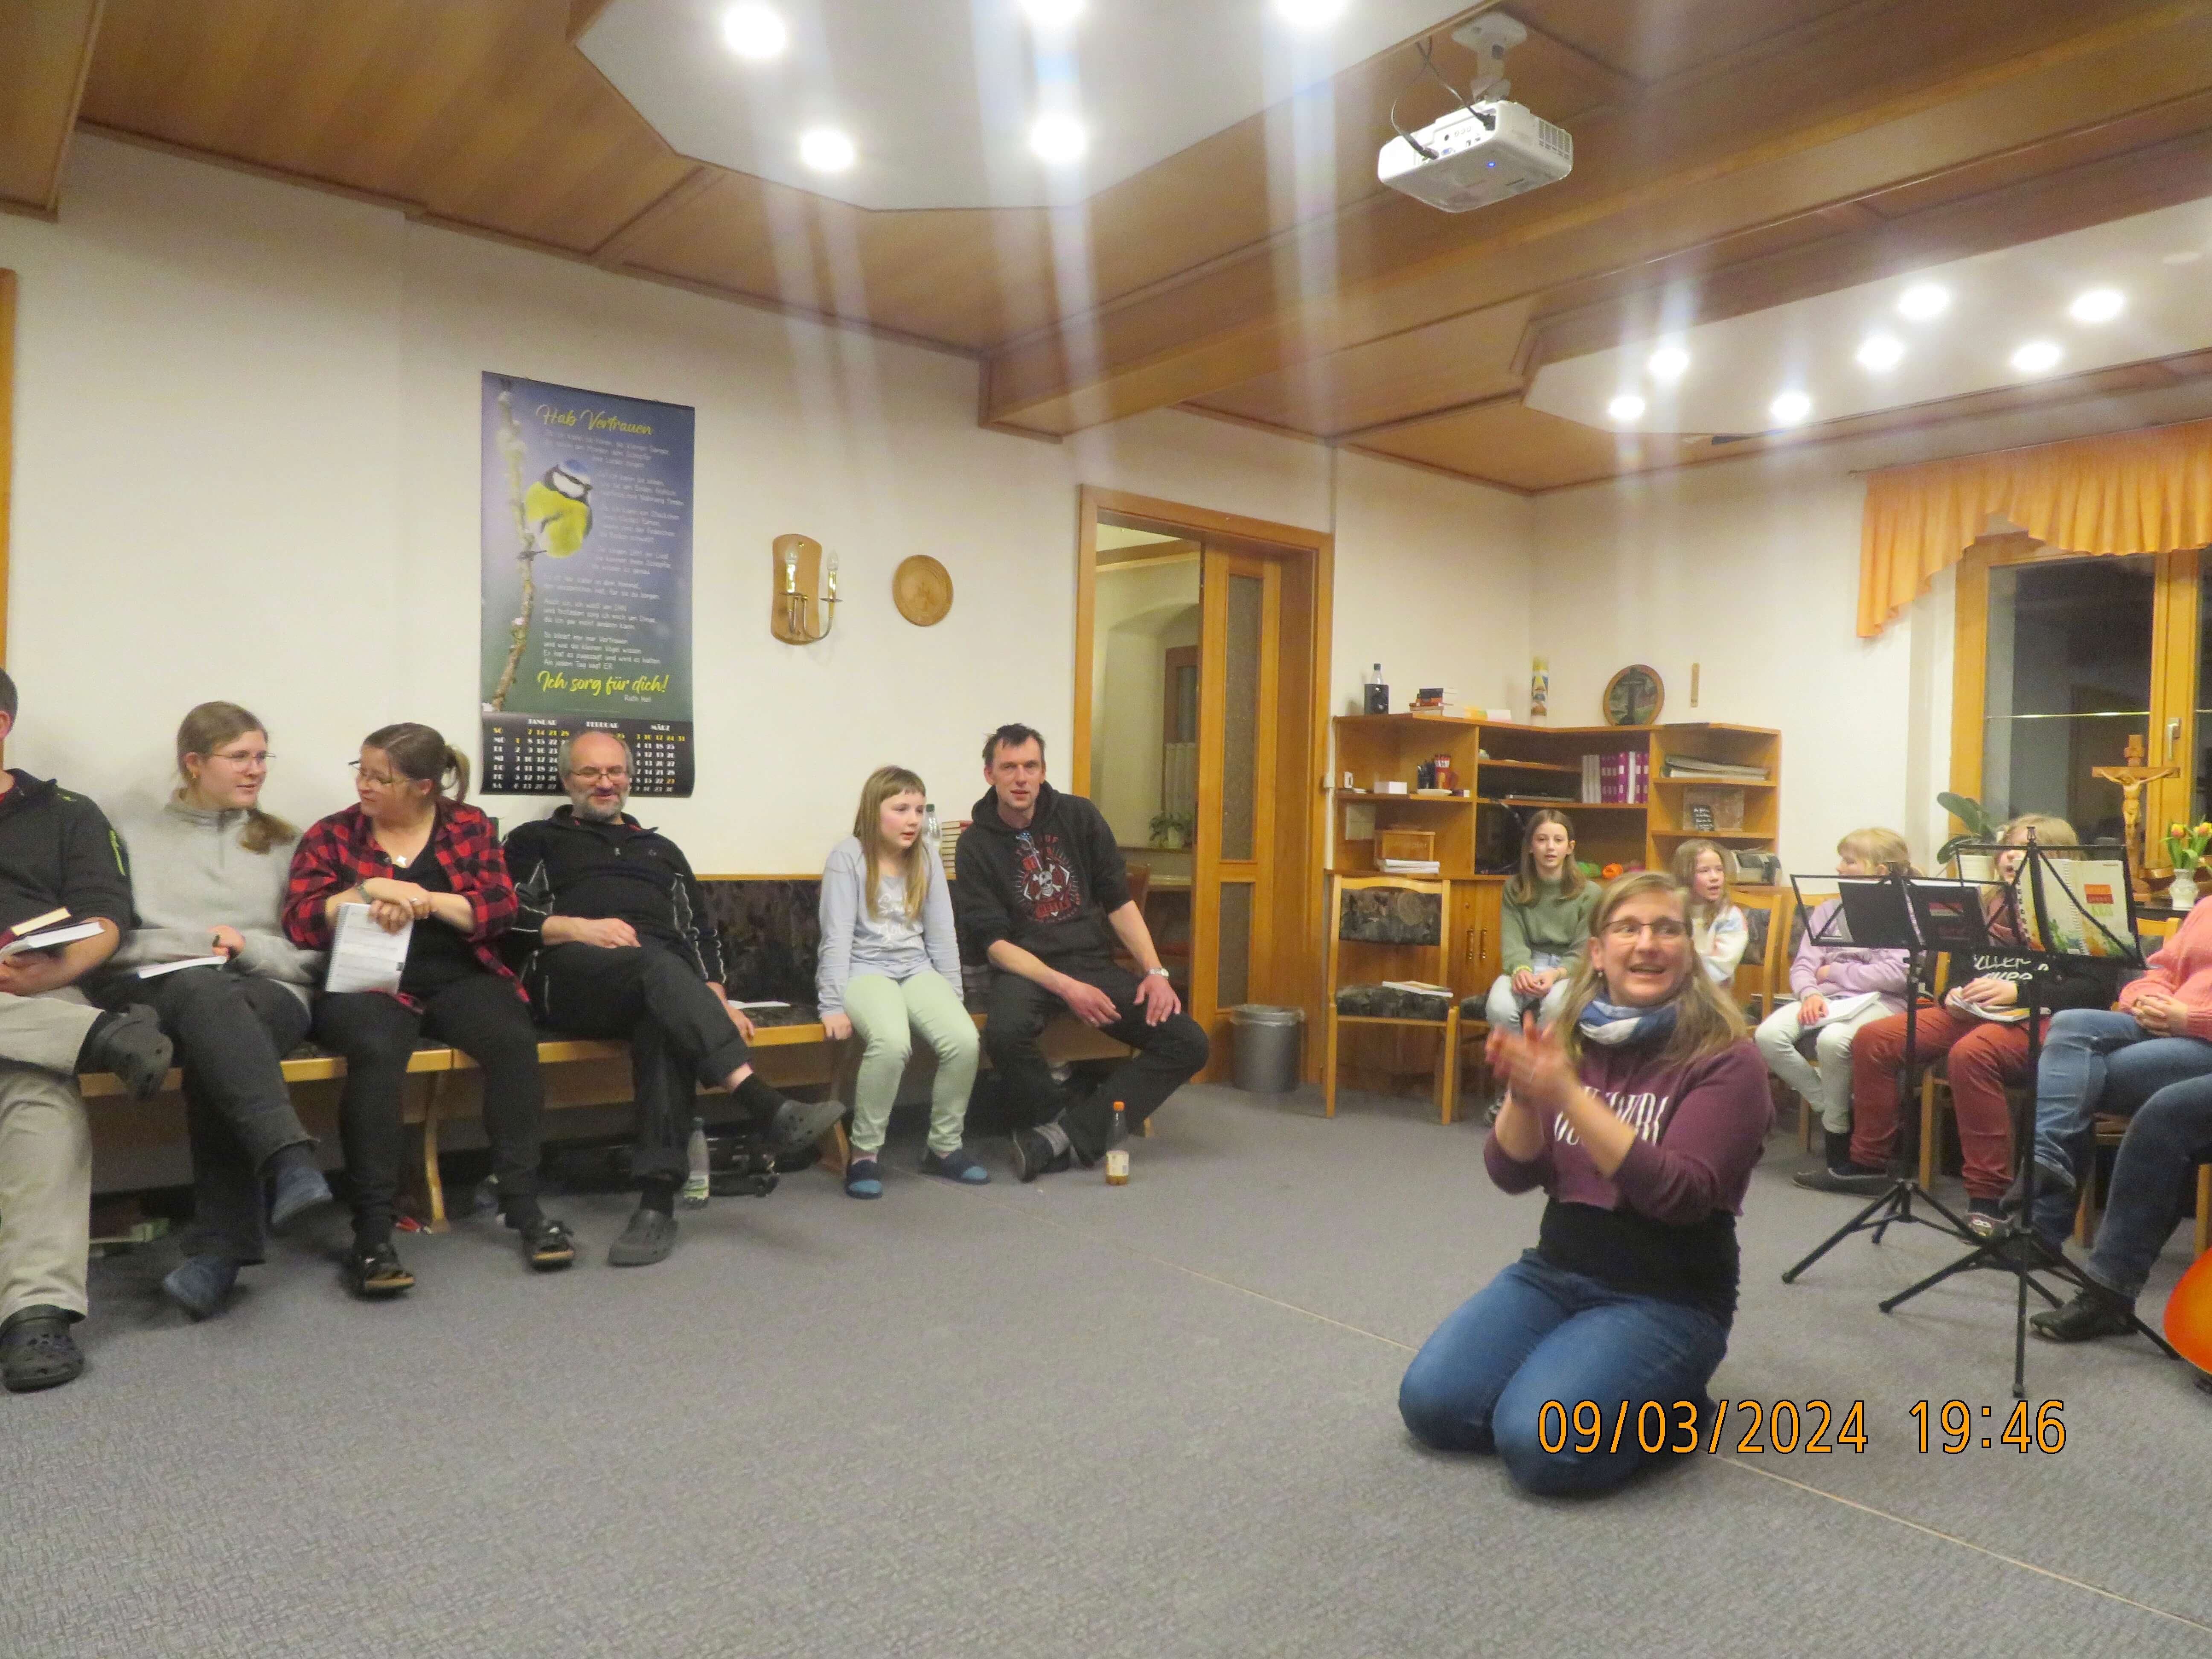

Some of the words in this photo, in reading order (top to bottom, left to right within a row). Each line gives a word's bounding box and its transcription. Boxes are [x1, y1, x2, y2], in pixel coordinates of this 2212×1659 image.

[536, 404, 577, 426] Hab
[580, 409, 653, 435] Vertrauen
[537, 670, 567, 693] Ich
[570, 678, 601, 696] sorg
[606, 676, 629, 696] für
[631, 674, 669, 694] dich!
[586, 721, 618, 729] FEBRUAR
[650, 723, 670, 731] MÄRZ
